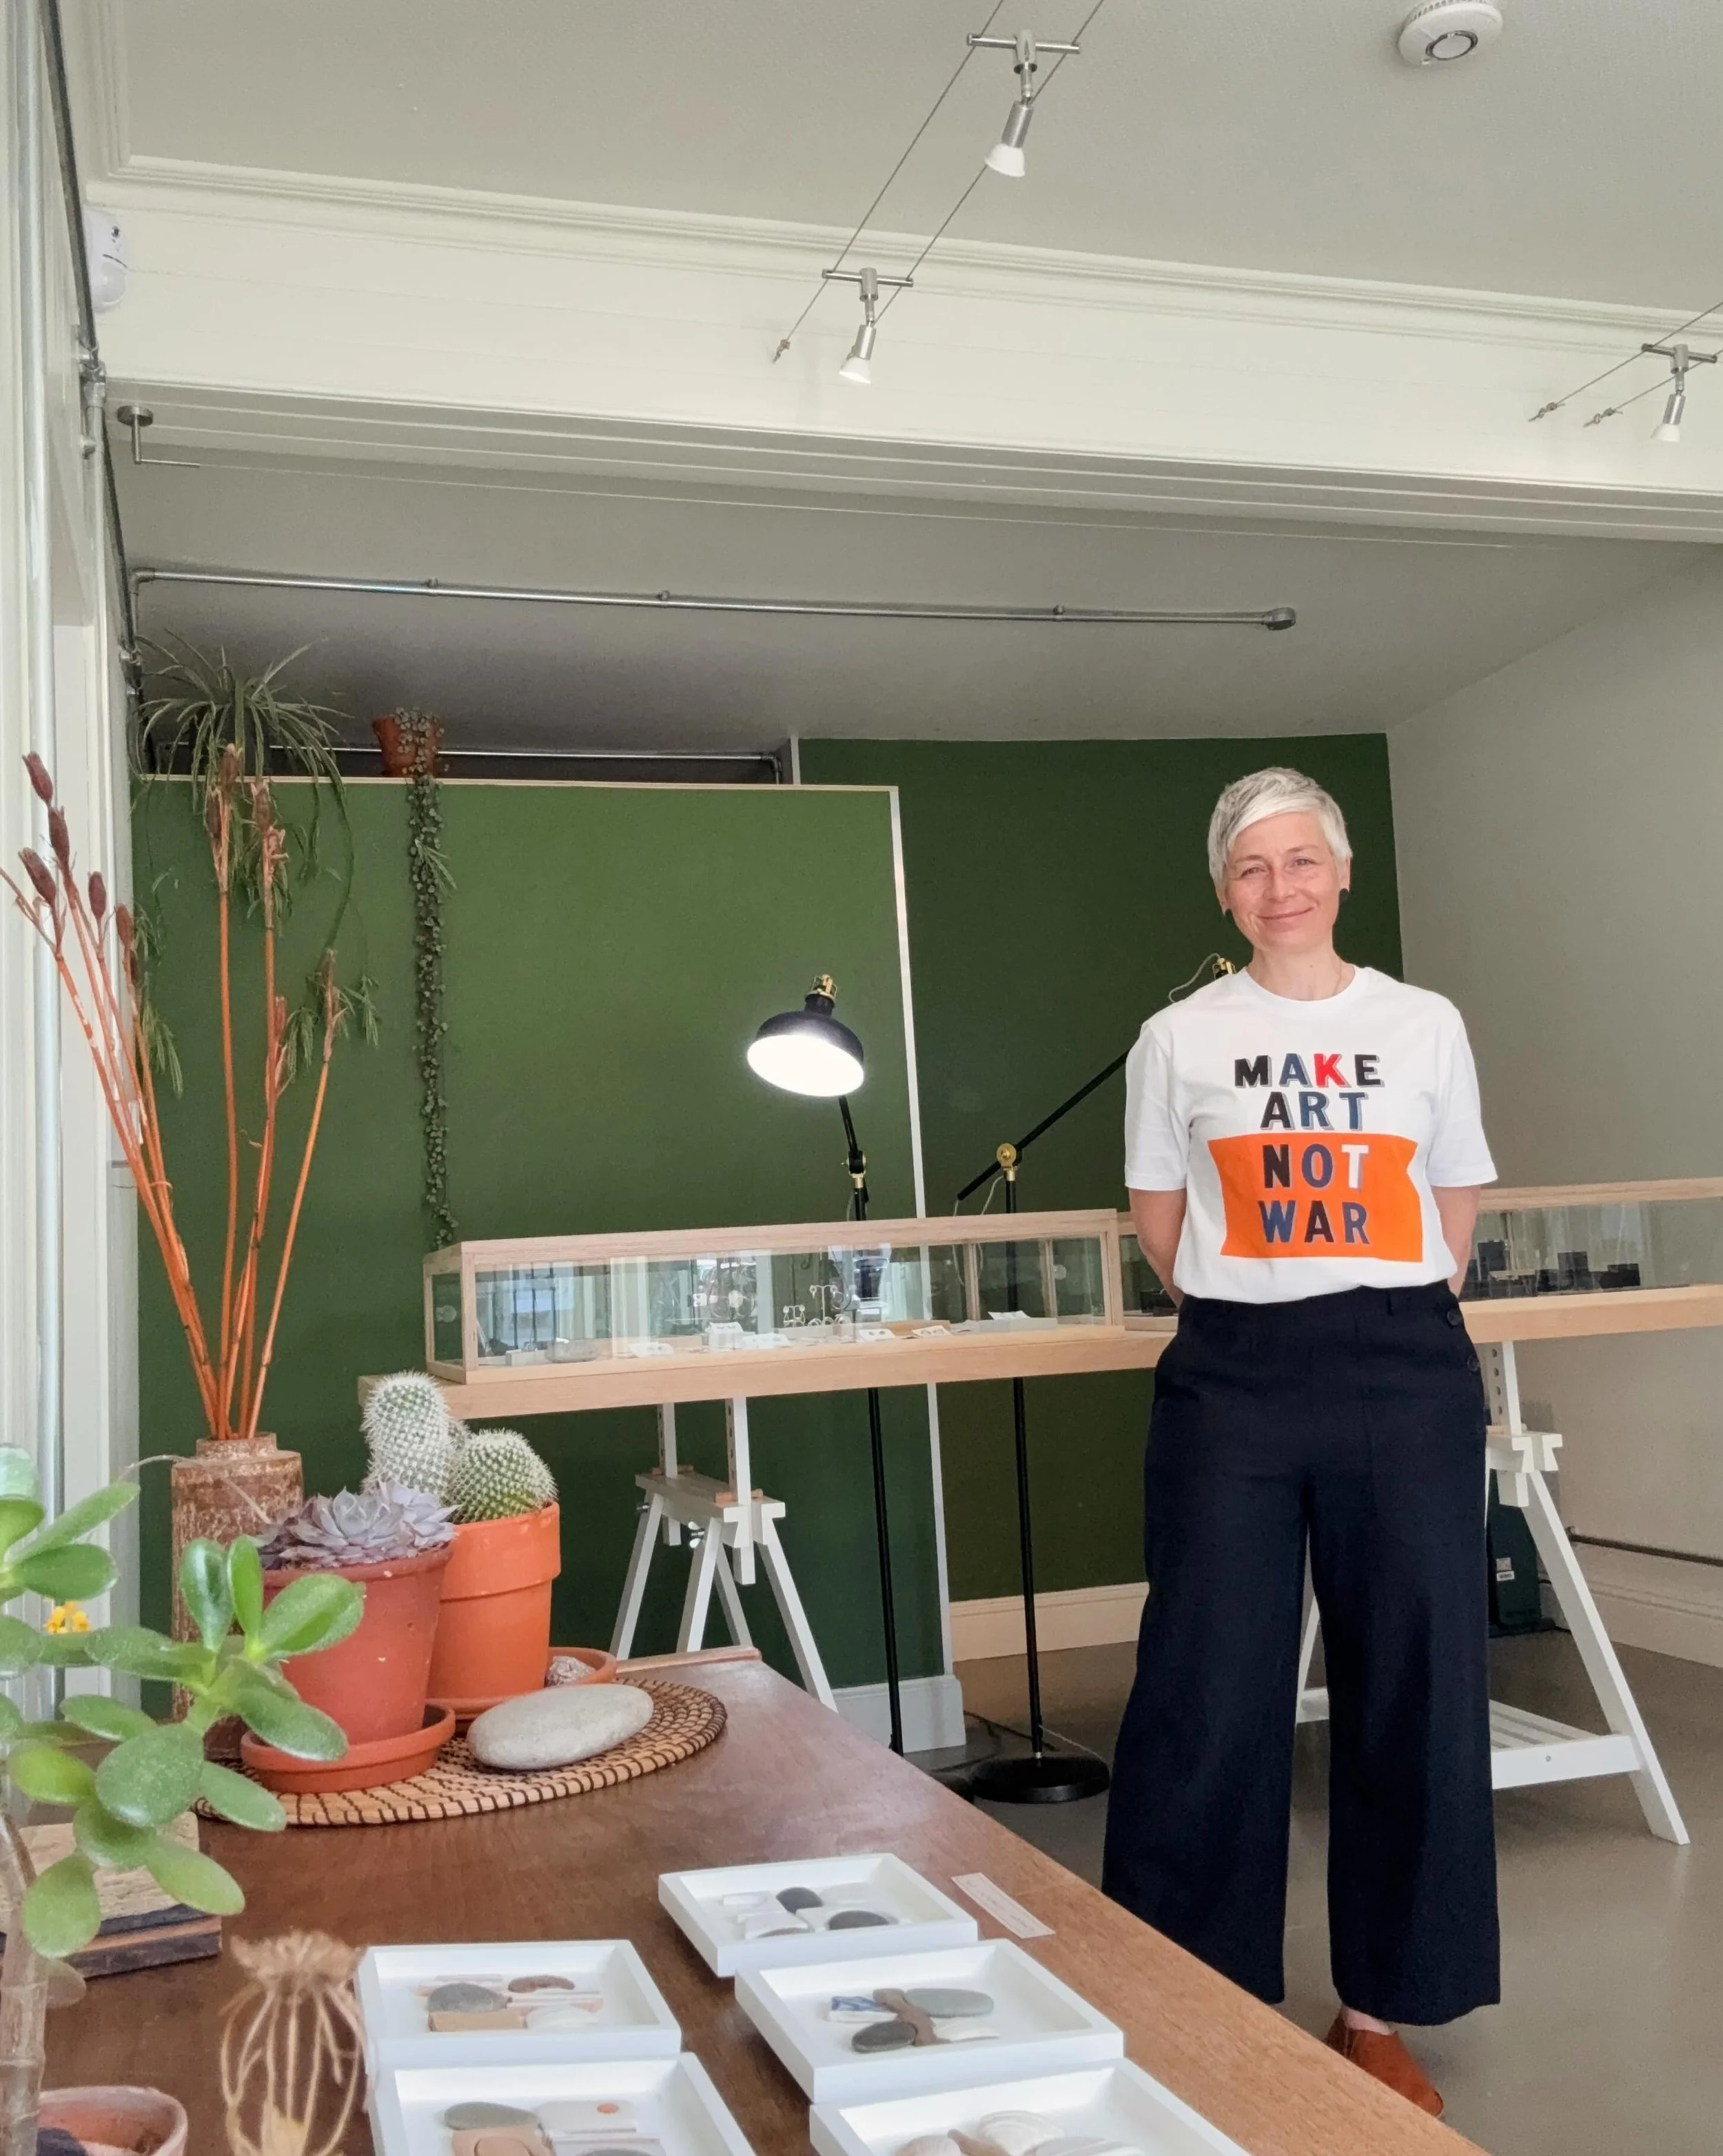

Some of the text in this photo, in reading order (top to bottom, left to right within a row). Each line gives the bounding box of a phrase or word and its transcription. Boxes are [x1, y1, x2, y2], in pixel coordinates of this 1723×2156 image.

[1234, 1052, 1385, 1088] MAKE
[1260, 1091, 1369, 1131] ART
[1263, 1143, 1369, 1192] NOT
[1258, 1200, 1370, 1245] WAR
